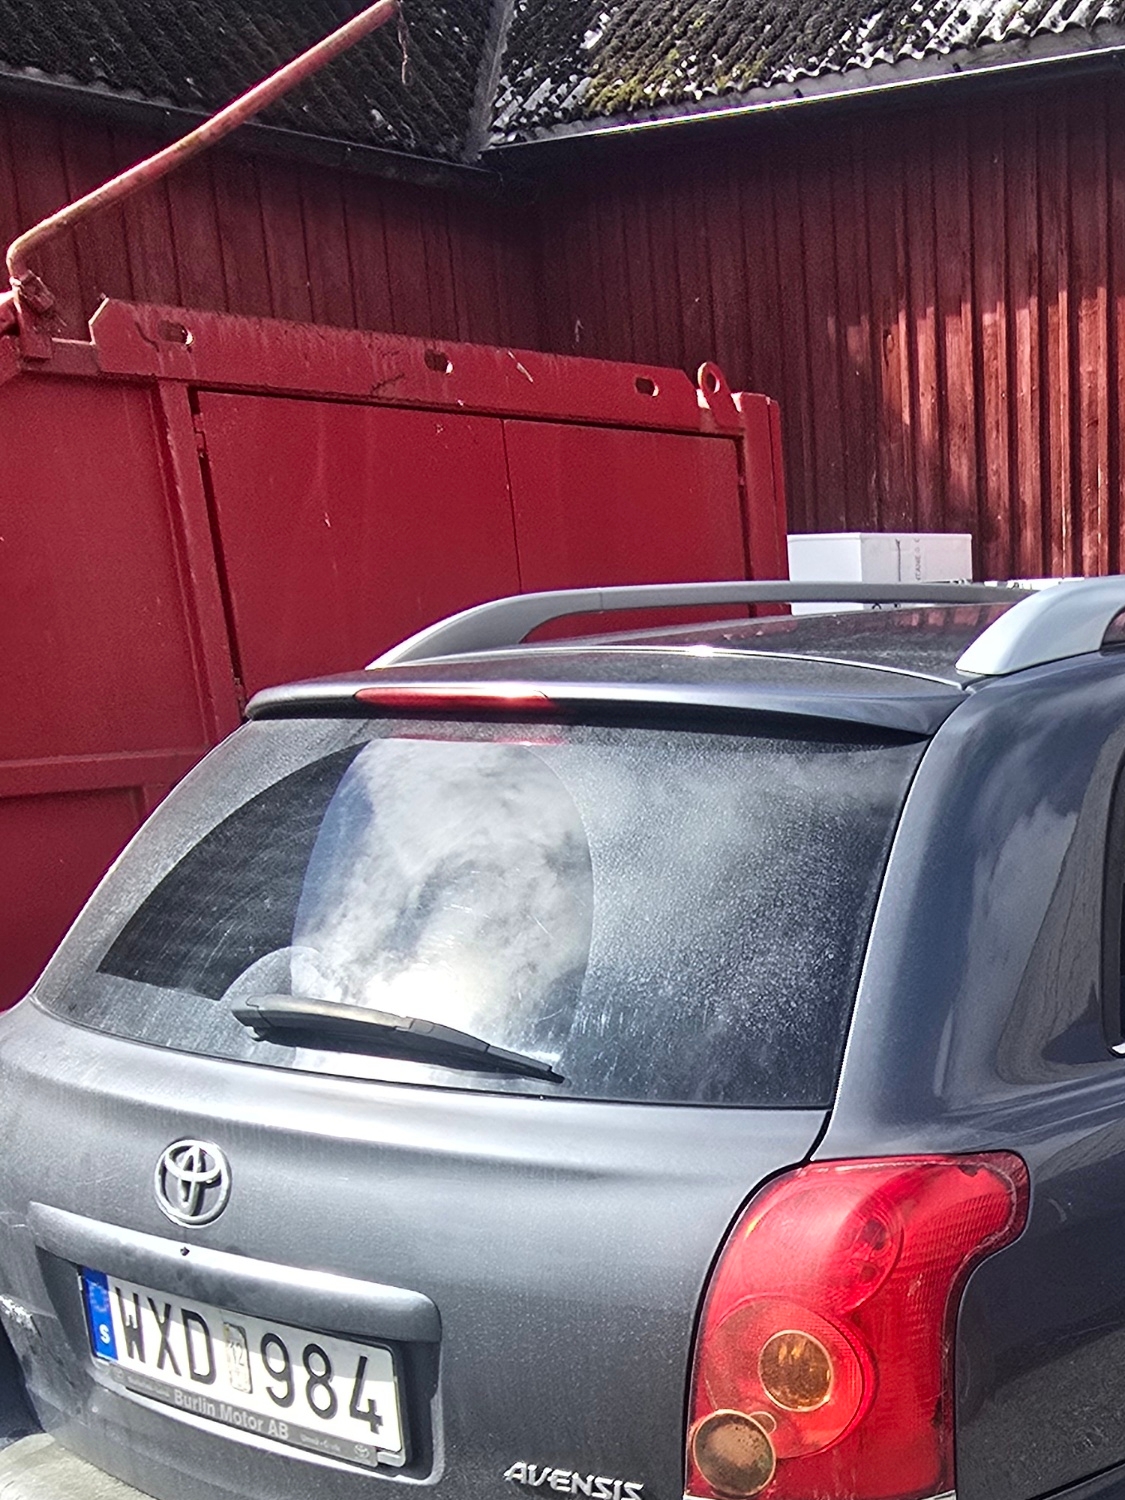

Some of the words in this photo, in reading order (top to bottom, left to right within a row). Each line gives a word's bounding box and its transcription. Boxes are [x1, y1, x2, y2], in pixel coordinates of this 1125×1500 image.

[115, 1286, 217, 1385] WXD
[260, 1332, 384, 1435] 984
[174, 1388, 216, 1417] Burlin
[220, 1404, 263, 1432] Motor
[268, 1418, 290, 1440] AB
